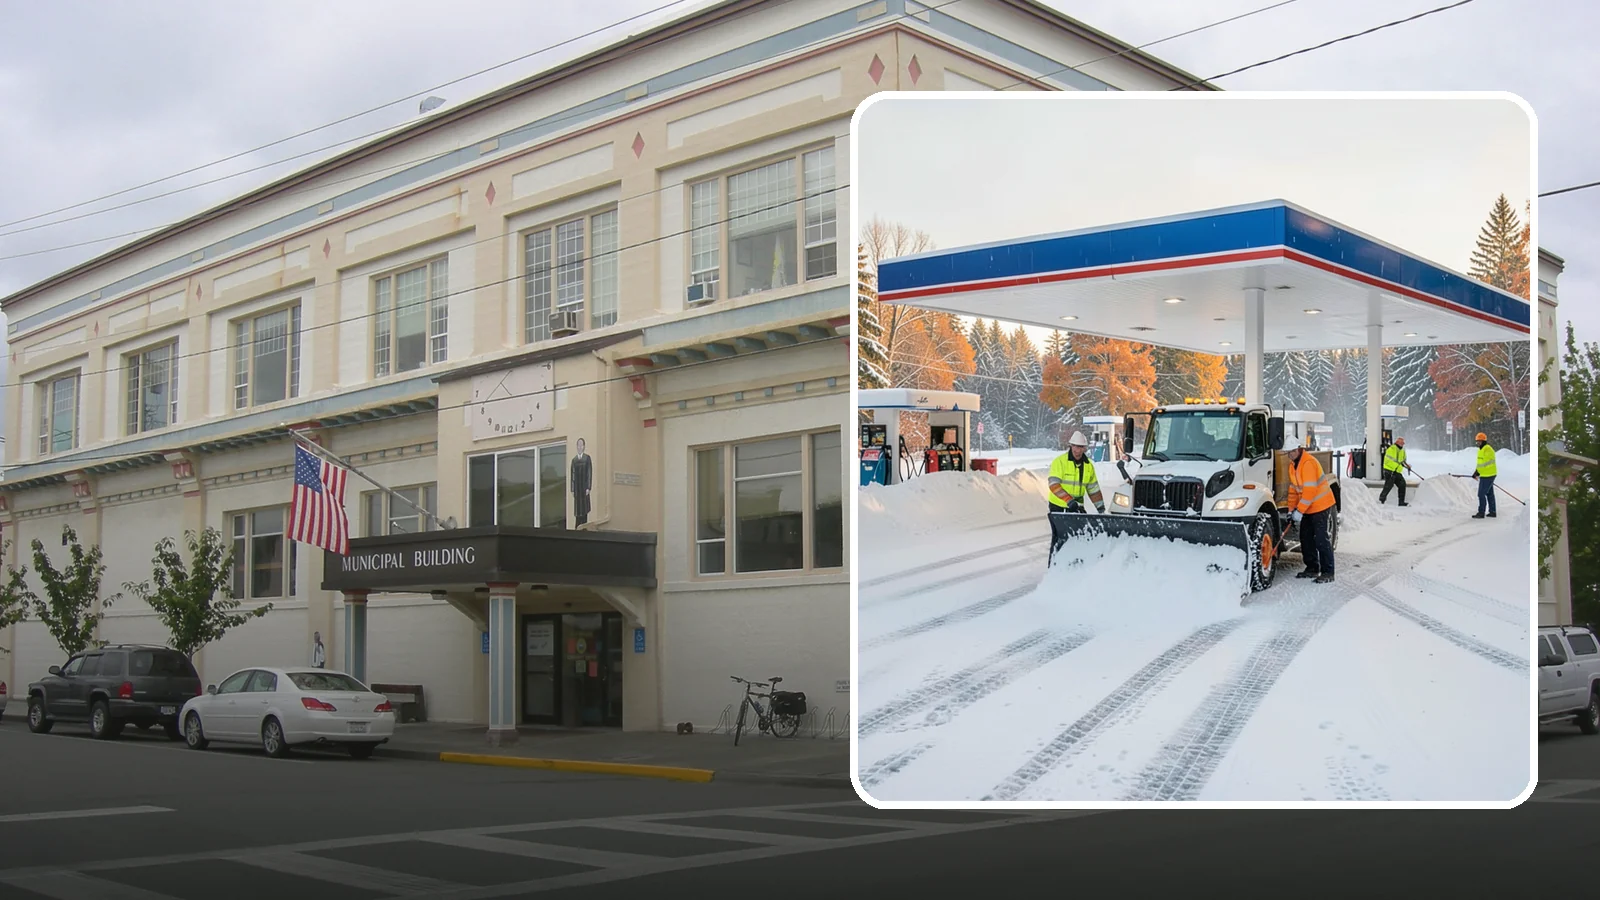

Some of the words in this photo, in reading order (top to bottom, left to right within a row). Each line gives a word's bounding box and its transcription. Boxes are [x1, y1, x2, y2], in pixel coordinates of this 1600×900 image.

[487, 417, 492, 426] 9
[494, 423, 500, 432] 10
[507, 425, 513, 433] 12
[342, 552, 405, 572] MUNICIPAL
[414, 546, 475, 567] BUILDING
